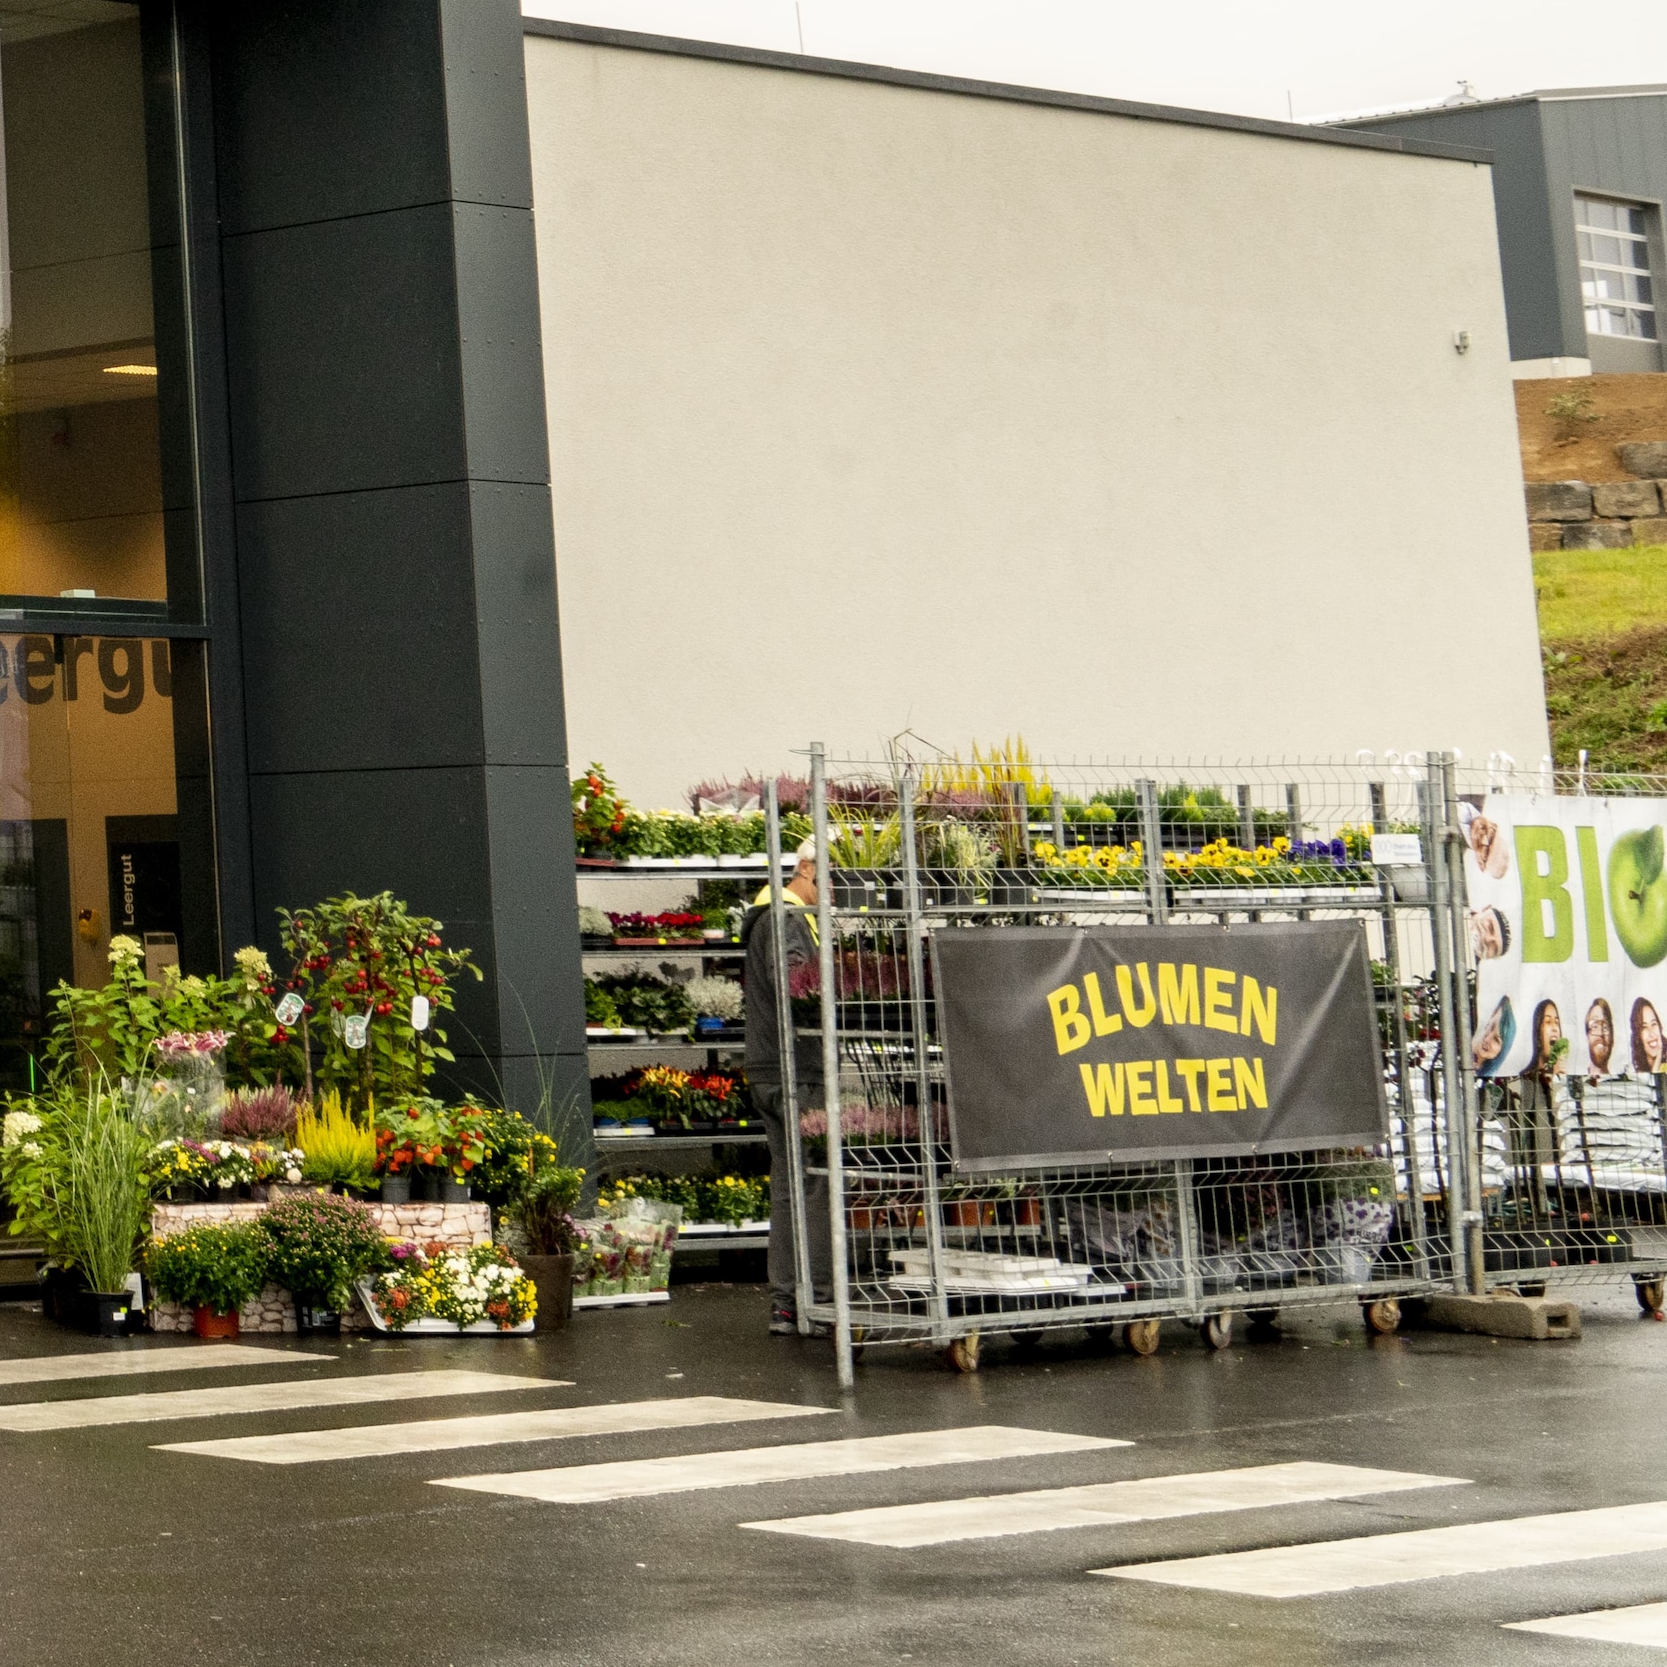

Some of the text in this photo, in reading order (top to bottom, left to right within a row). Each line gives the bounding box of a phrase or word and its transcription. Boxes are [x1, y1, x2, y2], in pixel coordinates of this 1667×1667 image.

[120, 853, 136, 926] Leergut
[1046, 961, 1278, 1056] BLUMEN
[1078, 1057, 1269, 1118] WELTEN
